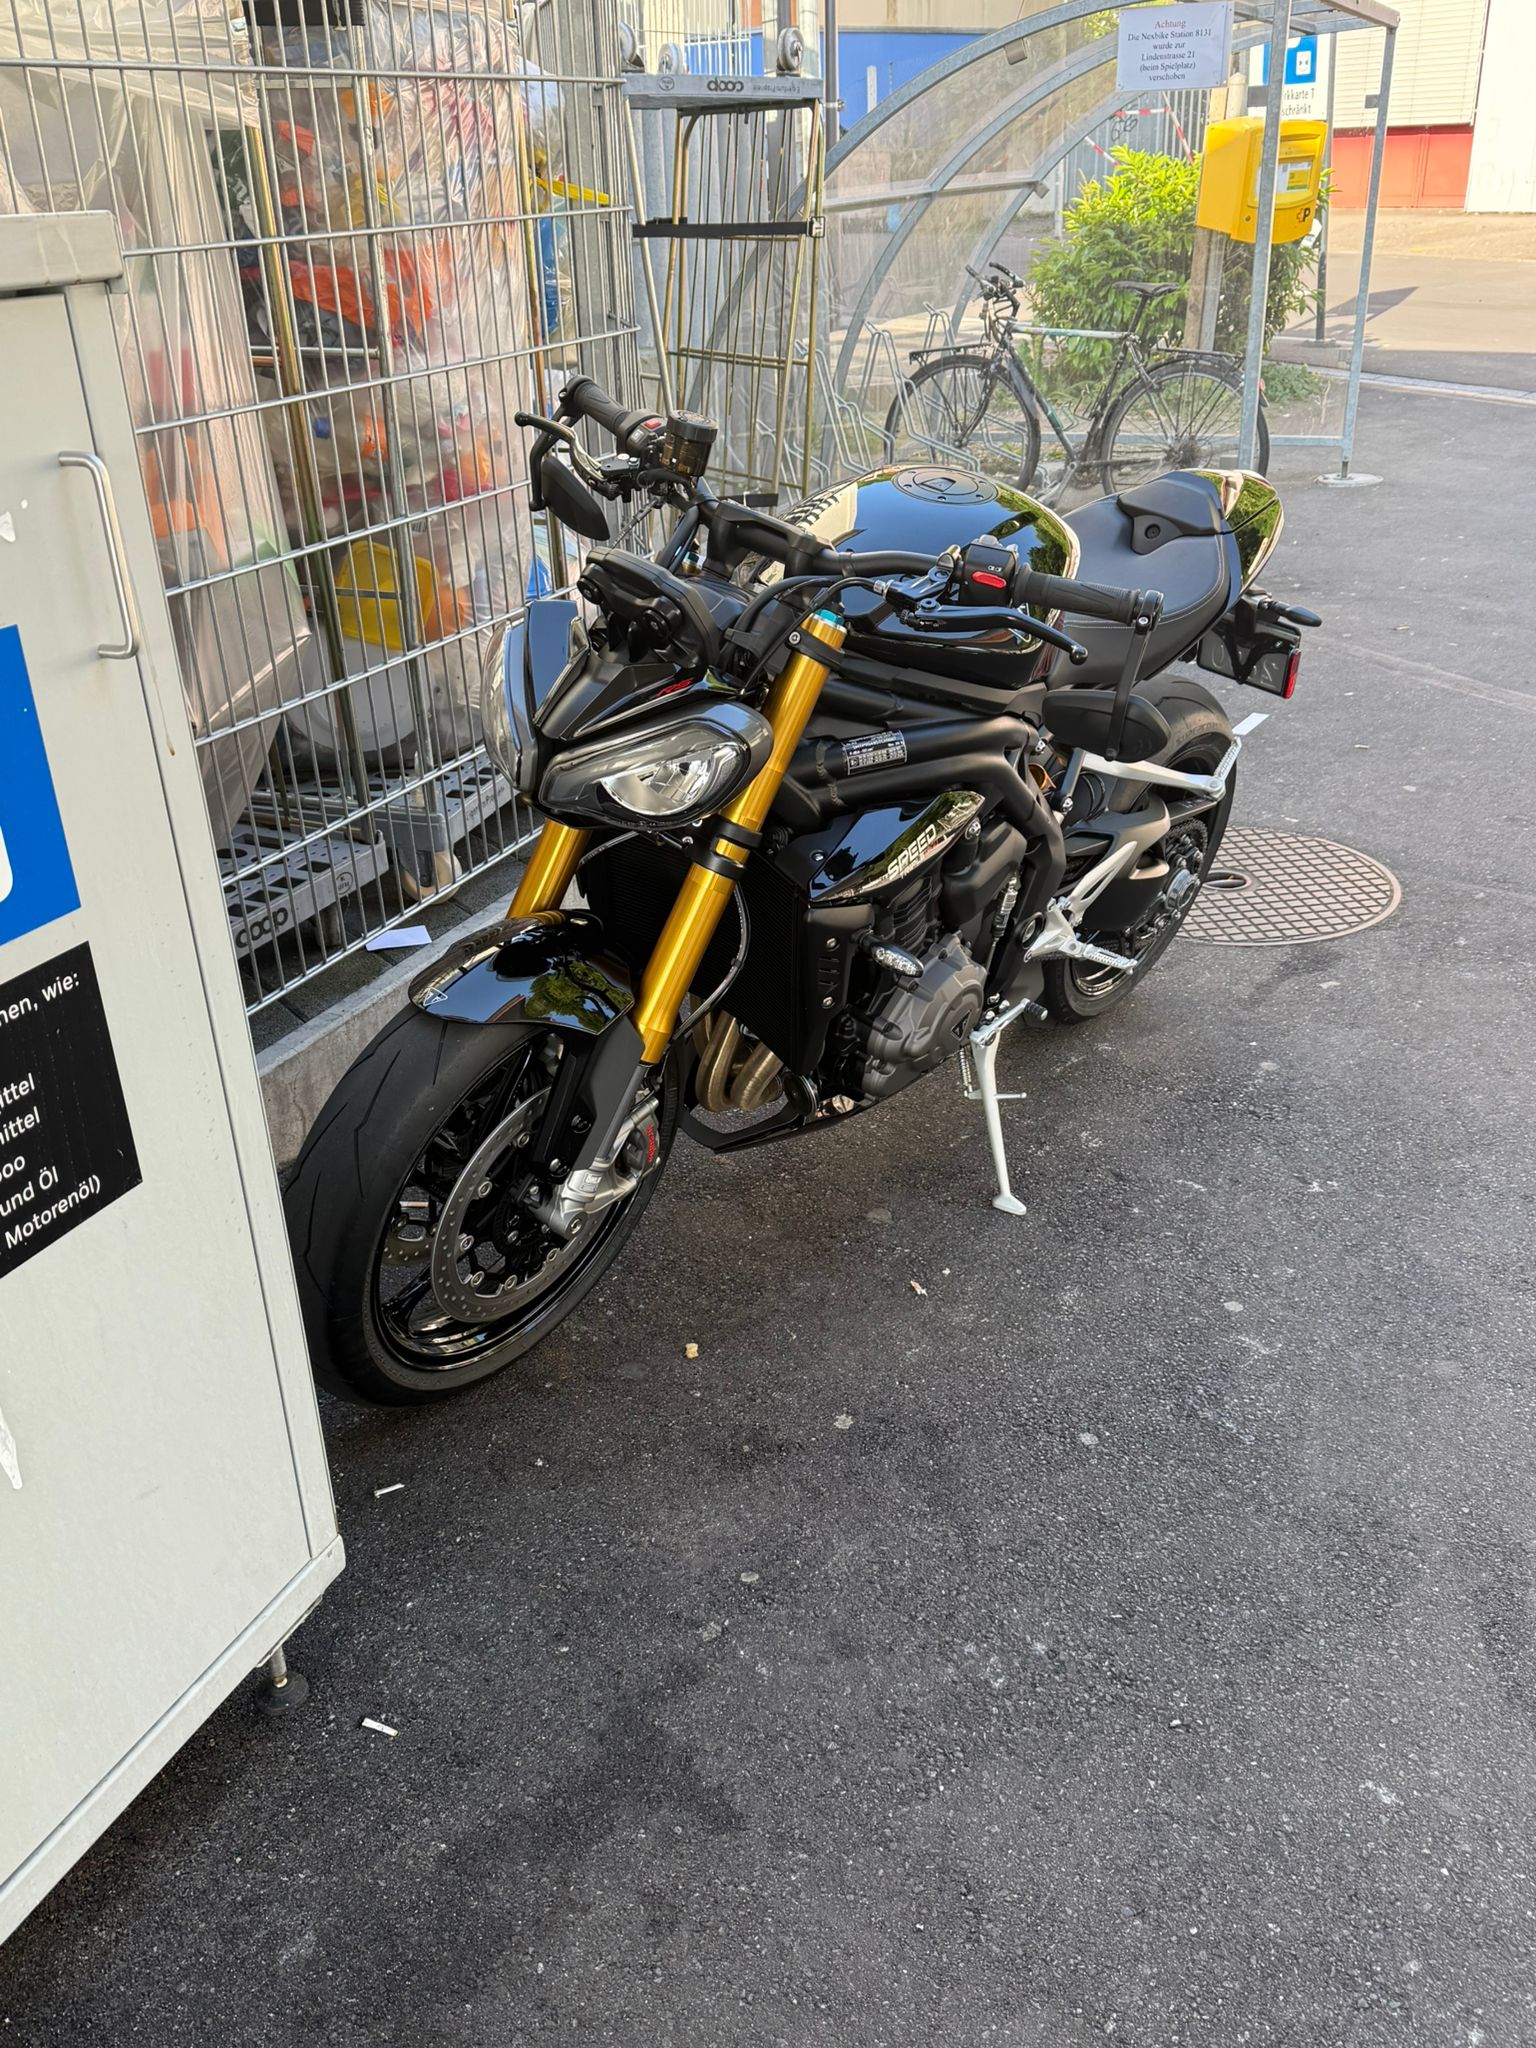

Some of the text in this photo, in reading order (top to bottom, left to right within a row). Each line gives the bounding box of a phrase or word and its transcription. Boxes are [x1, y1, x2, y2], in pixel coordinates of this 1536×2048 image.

[1154, 20, 1186, 29] Achtung
[1128, 28, 1211, 41] Die Nexbike Station 8131
[1152, 42, 1173, 50] wurde
[1141, 50, 1195, 61] Lindenstrasse 21
[1140, 61, 1196, 72] (beim Spielplatz)
[1149, 72, 1186, 81] verschoben
[707, 77, 744, 92] coop
[888, 824, 937, 880] SPEED
[235, 907, 289, 949] coop
[41, 972, 80, 1002] wie:
[0, 1165, 59, 1217] und Öl
[4, 1174, 101, 1249] Motorenöl)
